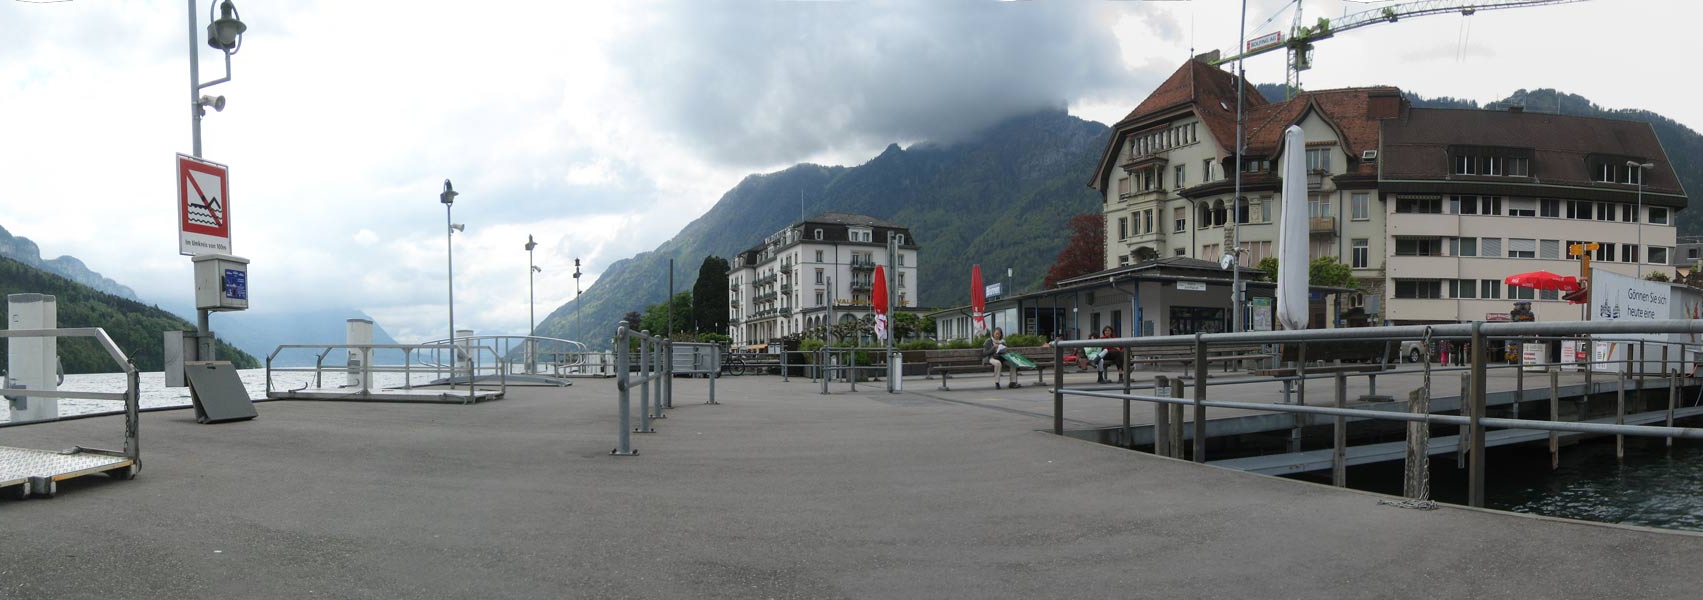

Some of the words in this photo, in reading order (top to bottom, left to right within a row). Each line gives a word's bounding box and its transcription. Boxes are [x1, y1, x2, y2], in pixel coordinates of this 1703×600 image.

[1627, 288, 1650, 302] Gönnen
[1657, 293, 1667, 305] sich
[1627, 304, 1643, 318] heute
[1643, 307, 1656, 319] eine
